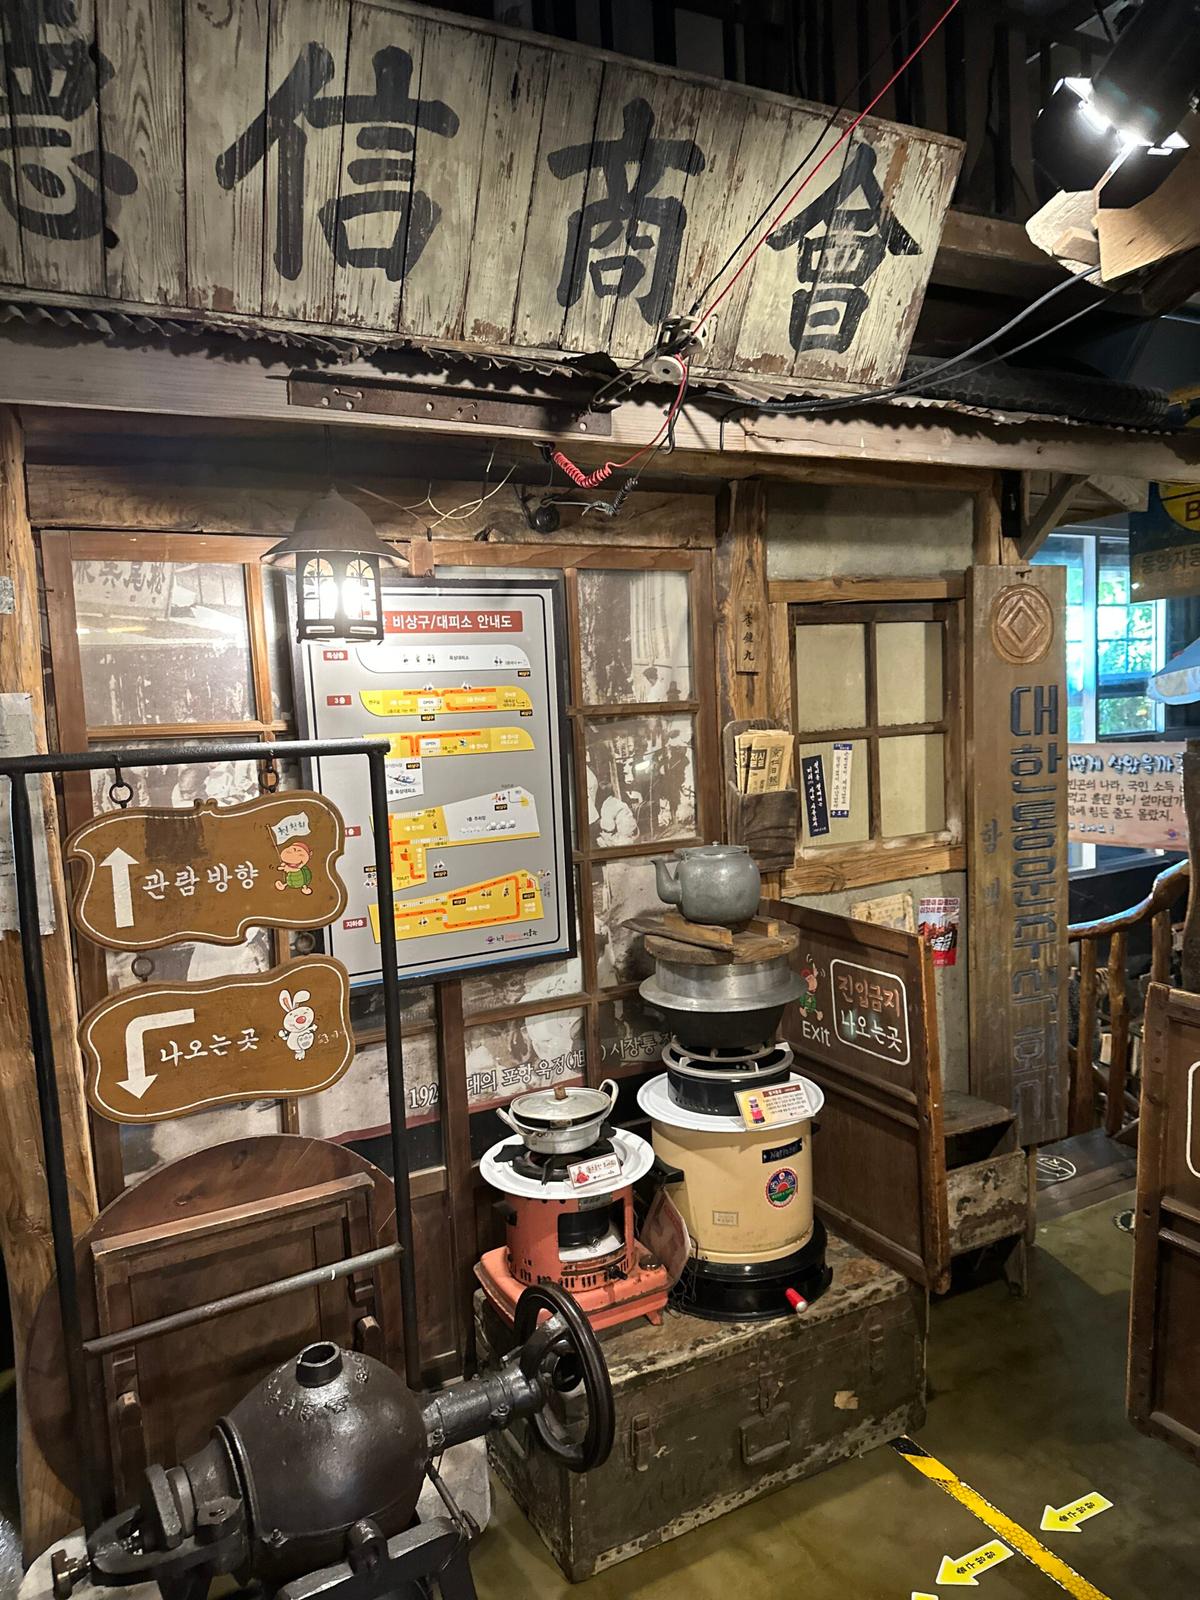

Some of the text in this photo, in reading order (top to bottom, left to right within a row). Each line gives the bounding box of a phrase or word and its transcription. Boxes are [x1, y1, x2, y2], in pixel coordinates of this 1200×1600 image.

[392, 614, 473, 630] 비상구/대피소
[477, 614, 513, 629] 안내도
[1068, 753, 1104, 774] 떻게
[1127, 780, 1149, 793] 국민
[1152, 780, 1175, 793] 소득
[1112, 807, 1133, 820] 줄도
[141, 860, 260, 901] 관람 방향
[837, 974, 901, 1019] 진입금지
[159, 1027, 260, 1069] 나오는 곳
[501, 1062, 535, 1087] 포항
[609, 1031, 659, 1060] 시장통
[1058, 1501, 1096, 1522] 출구방향
[956, 1550, 996, 1575] 출구방향
